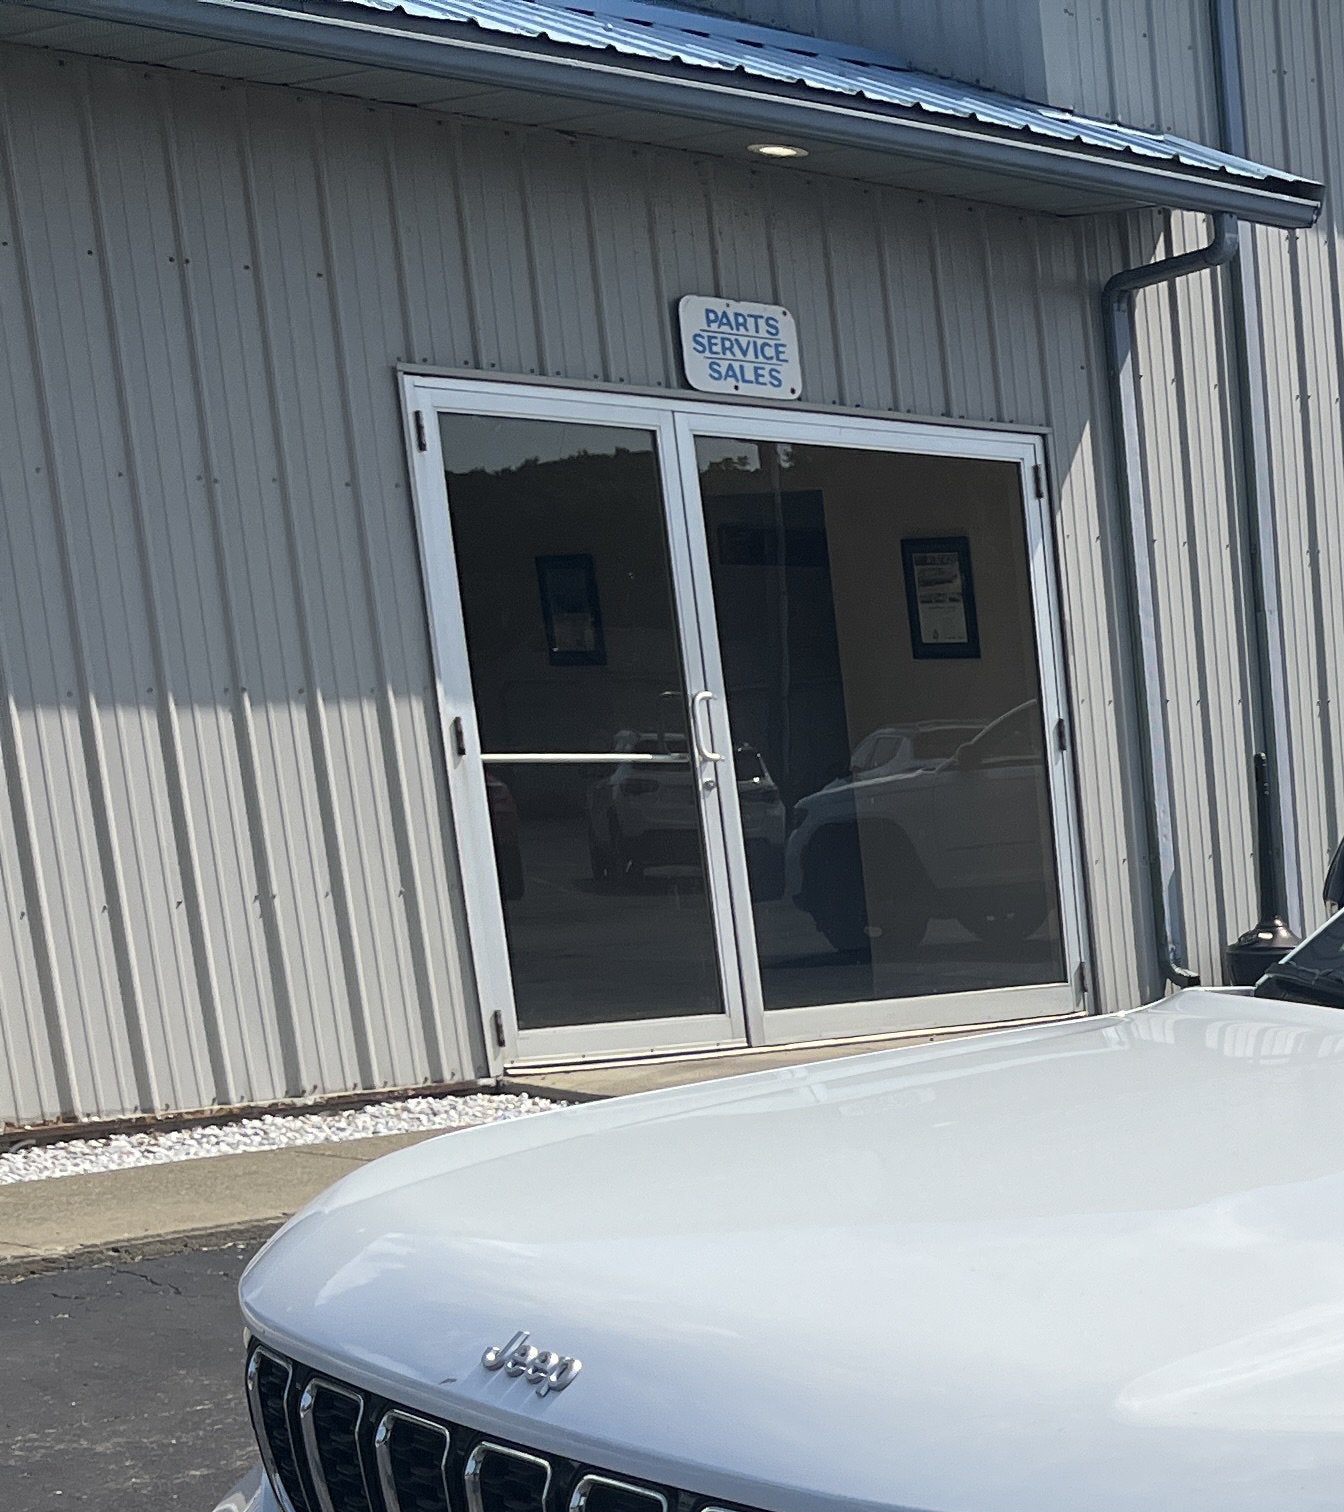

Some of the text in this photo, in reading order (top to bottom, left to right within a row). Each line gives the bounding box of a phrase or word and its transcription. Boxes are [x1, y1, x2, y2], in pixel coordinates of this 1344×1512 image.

[705, 308, 780, 337] PARTS
[692, 333, 789, 363] SERVICE
[708, 361, 783, 388] SALES
[481, 1330, 583, 1397] Jeep
